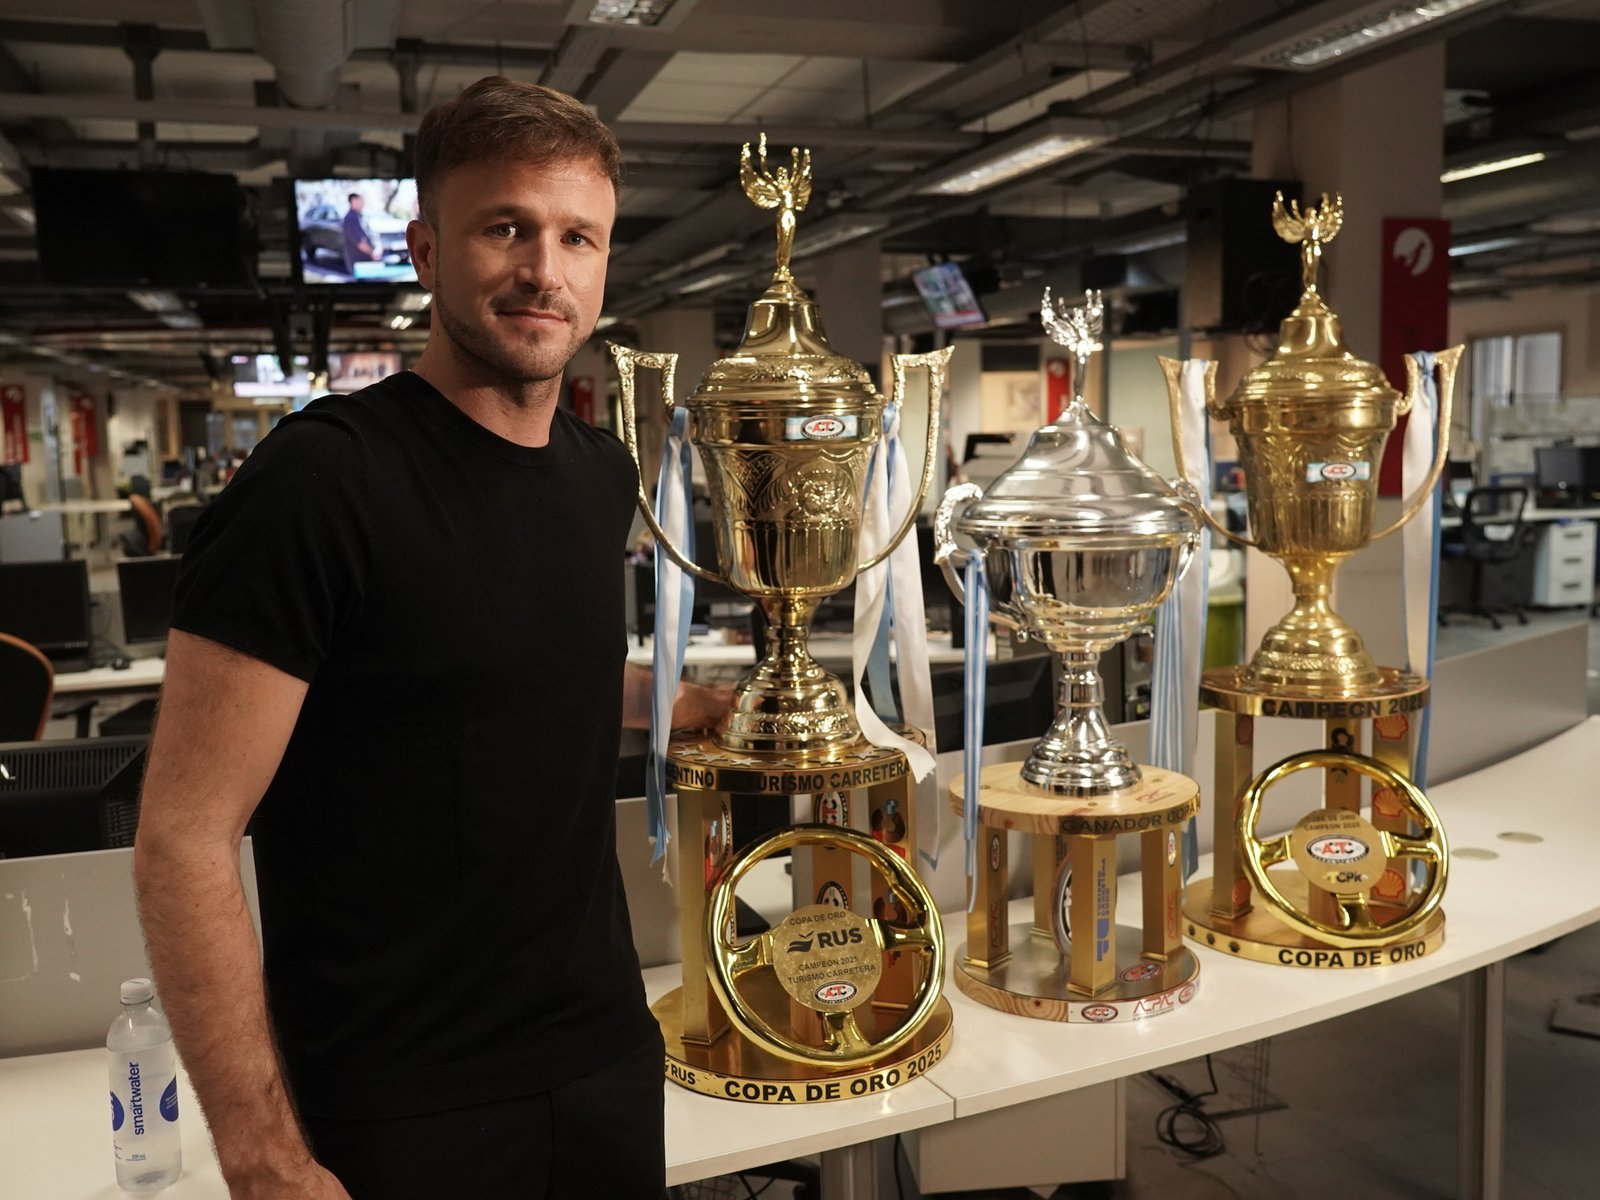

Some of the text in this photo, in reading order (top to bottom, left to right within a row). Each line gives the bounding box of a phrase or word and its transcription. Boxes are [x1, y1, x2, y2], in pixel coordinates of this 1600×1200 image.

[1262, 699, 1381, 718] CAMPEON
[830, 758, 909, 789] CARRETERA
[1062, 815, 1161, 833] GANADOR
[789, 911, 846, 926] COPA DE ORO
[817, 927, 863, 949] RUS
[799, 955, 859, 971] CAMPEON 2025
[1278, 941, 1426, 968] COPA DE ORO
[788, 964, 876, 984] TURISMO CARRETERA
[671, 1064, 696, 1085] RUS
[724, 1043, 942, 1102] COPA DE ORO 2025
[128, 1062, 144, 1135] smartwater
